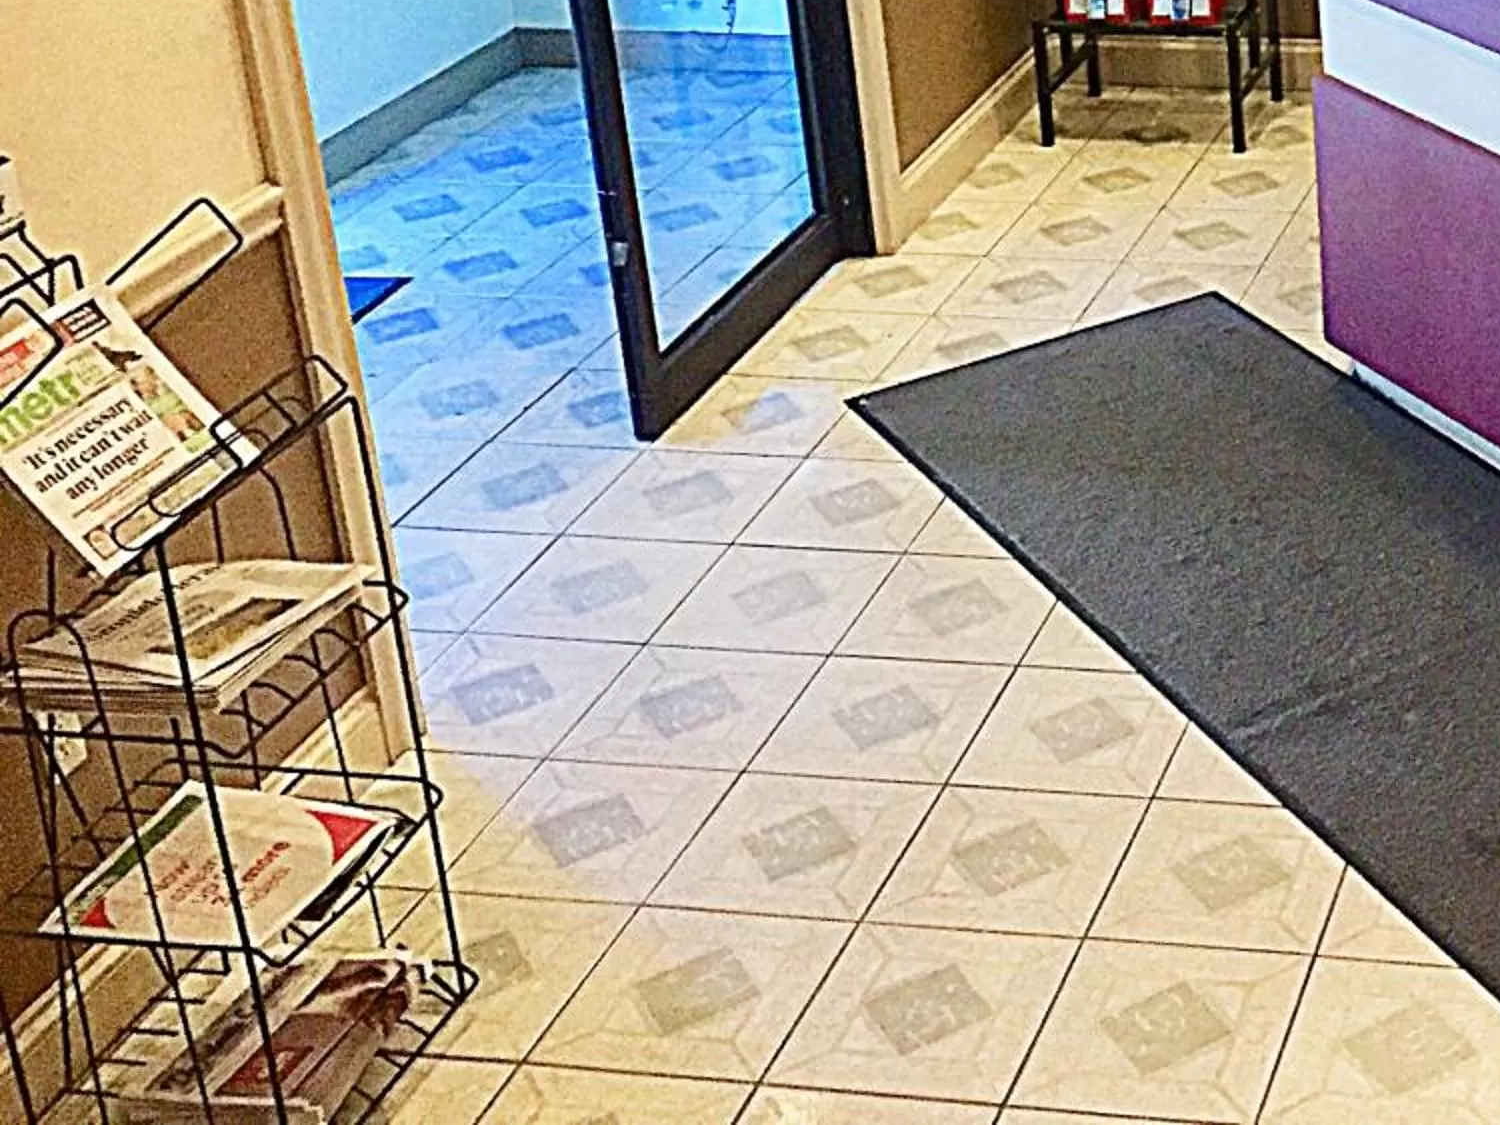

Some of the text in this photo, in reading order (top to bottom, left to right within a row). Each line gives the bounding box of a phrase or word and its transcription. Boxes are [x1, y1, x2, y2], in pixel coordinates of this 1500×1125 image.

[35, 462, 69, 493] and
[62, 457, 81, 473] it
[118, 410, 153, 435] wait
[54, 397, 134, 453] necessary
[66, 476, 99, 500] any
